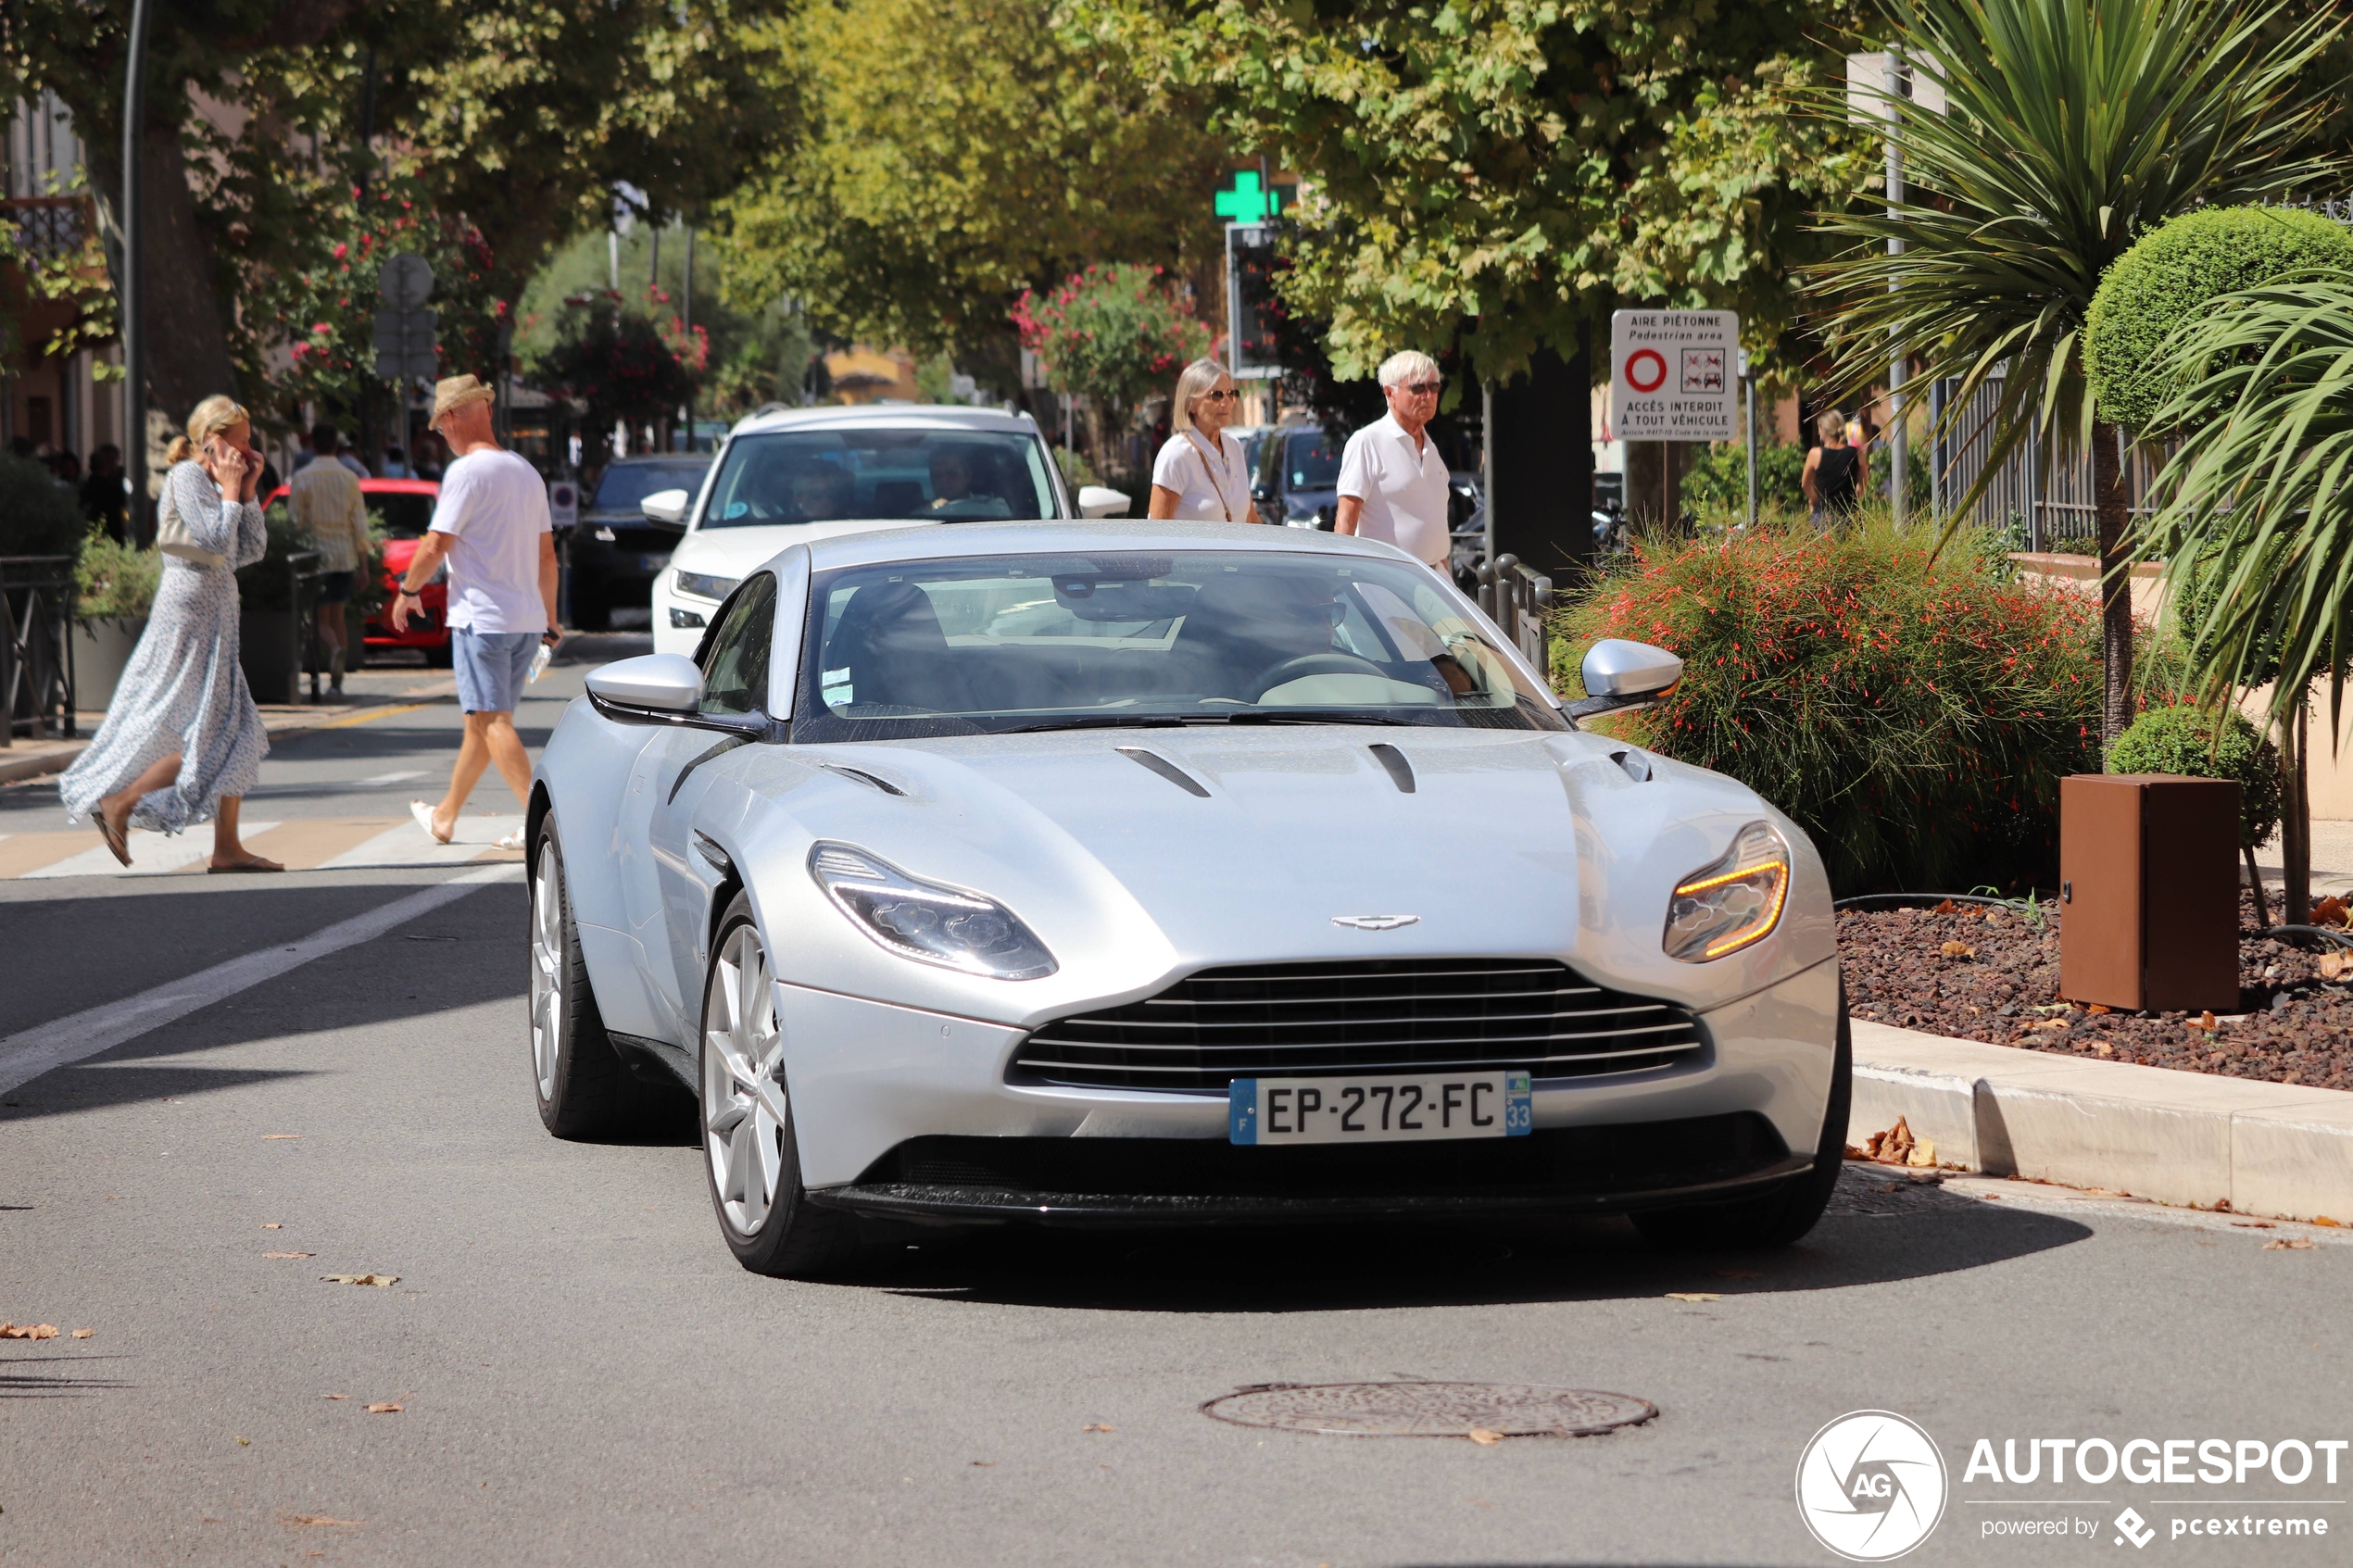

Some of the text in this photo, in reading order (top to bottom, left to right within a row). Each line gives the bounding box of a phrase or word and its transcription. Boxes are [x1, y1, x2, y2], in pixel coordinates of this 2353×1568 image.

[1631, 314, 1721, 327] AIRE PIÉTONNE
[1629, 330, 1723, 341] Pedestrian area
[1627, 400, 1723, 412] ACCÈS INTERDIT
[1621, 413, 1729, 426] À TOUT VÉHICULE
[1268, 1082, 1493, 1133] EP-272-FC
[1507, 1105, 1530, 1128] 33
[1239, 1118, 1248, 1132] F
